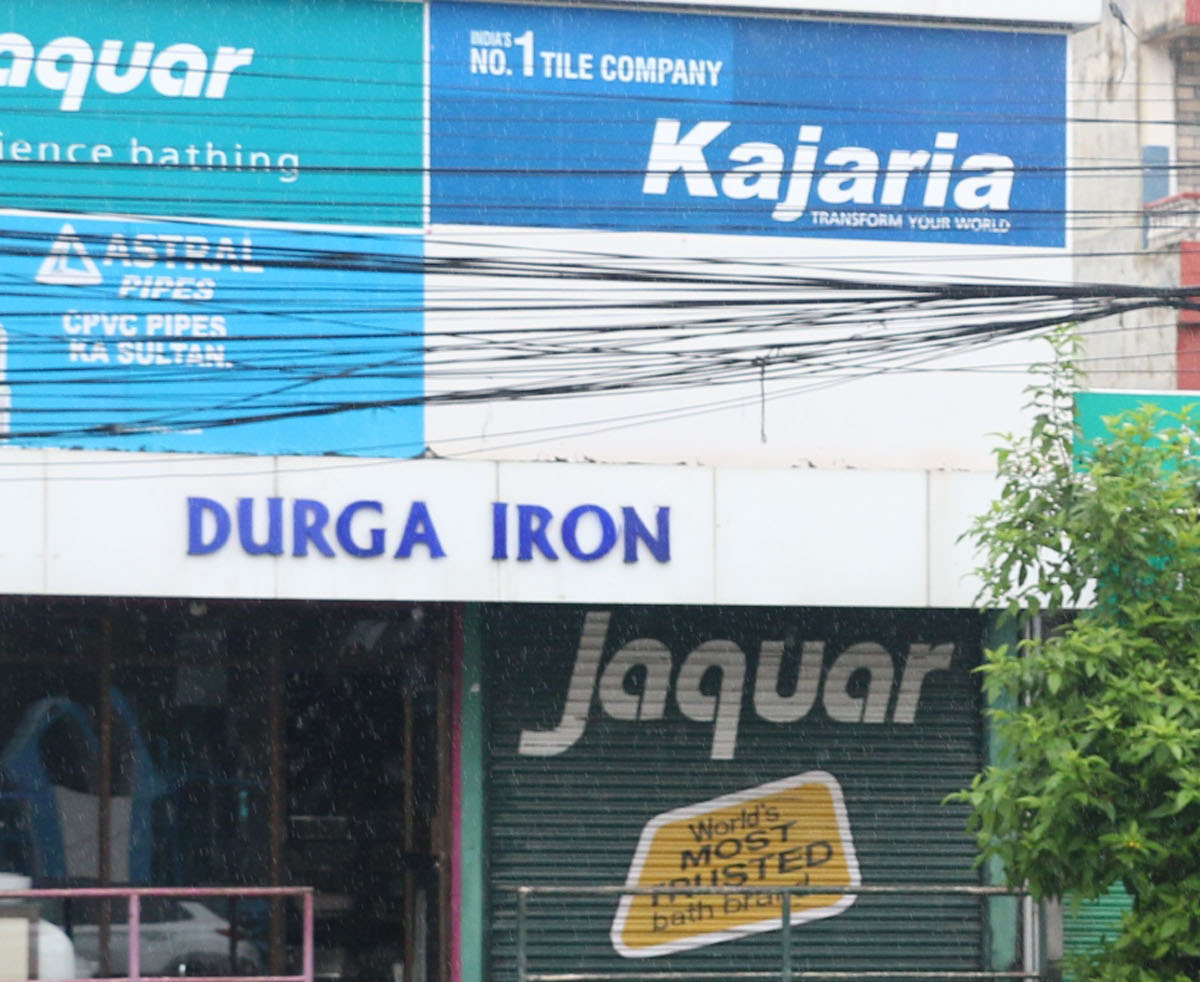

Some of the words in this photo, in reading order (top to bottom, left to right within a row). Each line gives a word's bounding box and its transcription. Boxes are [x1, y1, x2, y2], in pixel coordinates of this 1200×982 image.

[470, 30, 512, 48] INDIA'S
[470, 48, 513, 76] NO.
[514, 30, 534, 77] 1
[540, 52, 594, 80] TILE
[601, 54, 723, 87] COMPANY
[131, 138, 300, 183] bathing
[642, 117, 1015, 221] Kajaria
[812, 211, 902, 228] TRANSFORM
[909, 216, 951, 231] YOUR
[954, 218, 1011, 233] WORLD
[103, 233, 264, 273] ASTRAL
[117, 274, 217, 301] PIPES
[62, 310, 138, 337] CPVC
[145, 313, 228, 338] PIPES
[69, 338, 110, 364] KA
[186, 496, 446, 559] DURGA
[491, 501, 671, 564] IRON
[517, 611, 956, 760] Jaquar
[688, 804, 781, 842] World's
[680, 820, 798, 871] MOST
[652, 900, 714, 932] bath
[723, 872, 810, 914] brad
